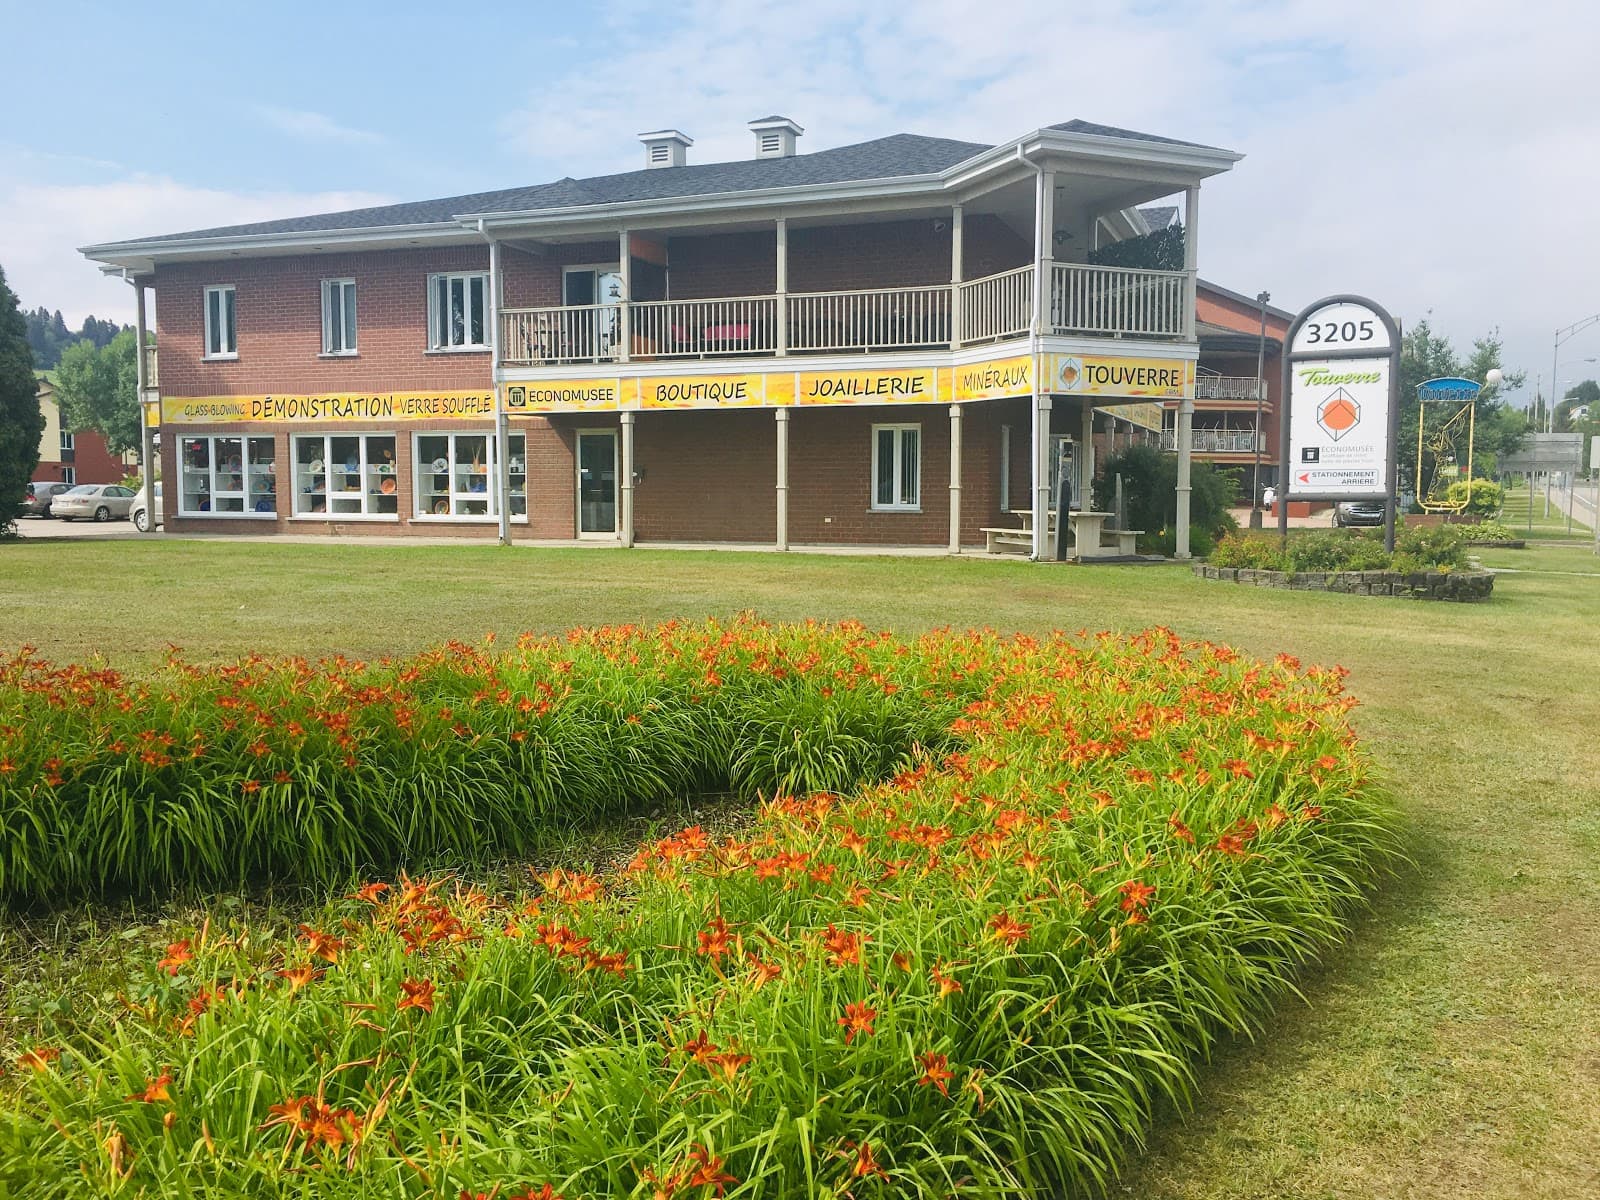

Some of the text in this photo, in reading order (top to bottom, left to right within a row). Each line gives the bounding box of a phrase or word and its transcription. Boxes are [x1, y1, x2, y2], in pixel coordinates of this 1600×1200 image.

[1306, 320, 1374, 344] 3205
[809, 376, 925, 397] JOAILLERIE
[963, 364, 1029, 392] MINÉRAUX
[1085, 365, 1179, 387] TOUVERRE
[1298, 367, 1381, 387] Touverre
[529, 388, 614, 402] ECONOMUSEE
[656, 382, 748, 402] BOUTIQUE
[252, 395, 393, 418] DÉMONSTRATION
[400, 398, 440, 414] VERRE
[442, 395, 491, 414] SOUFFLÉ
